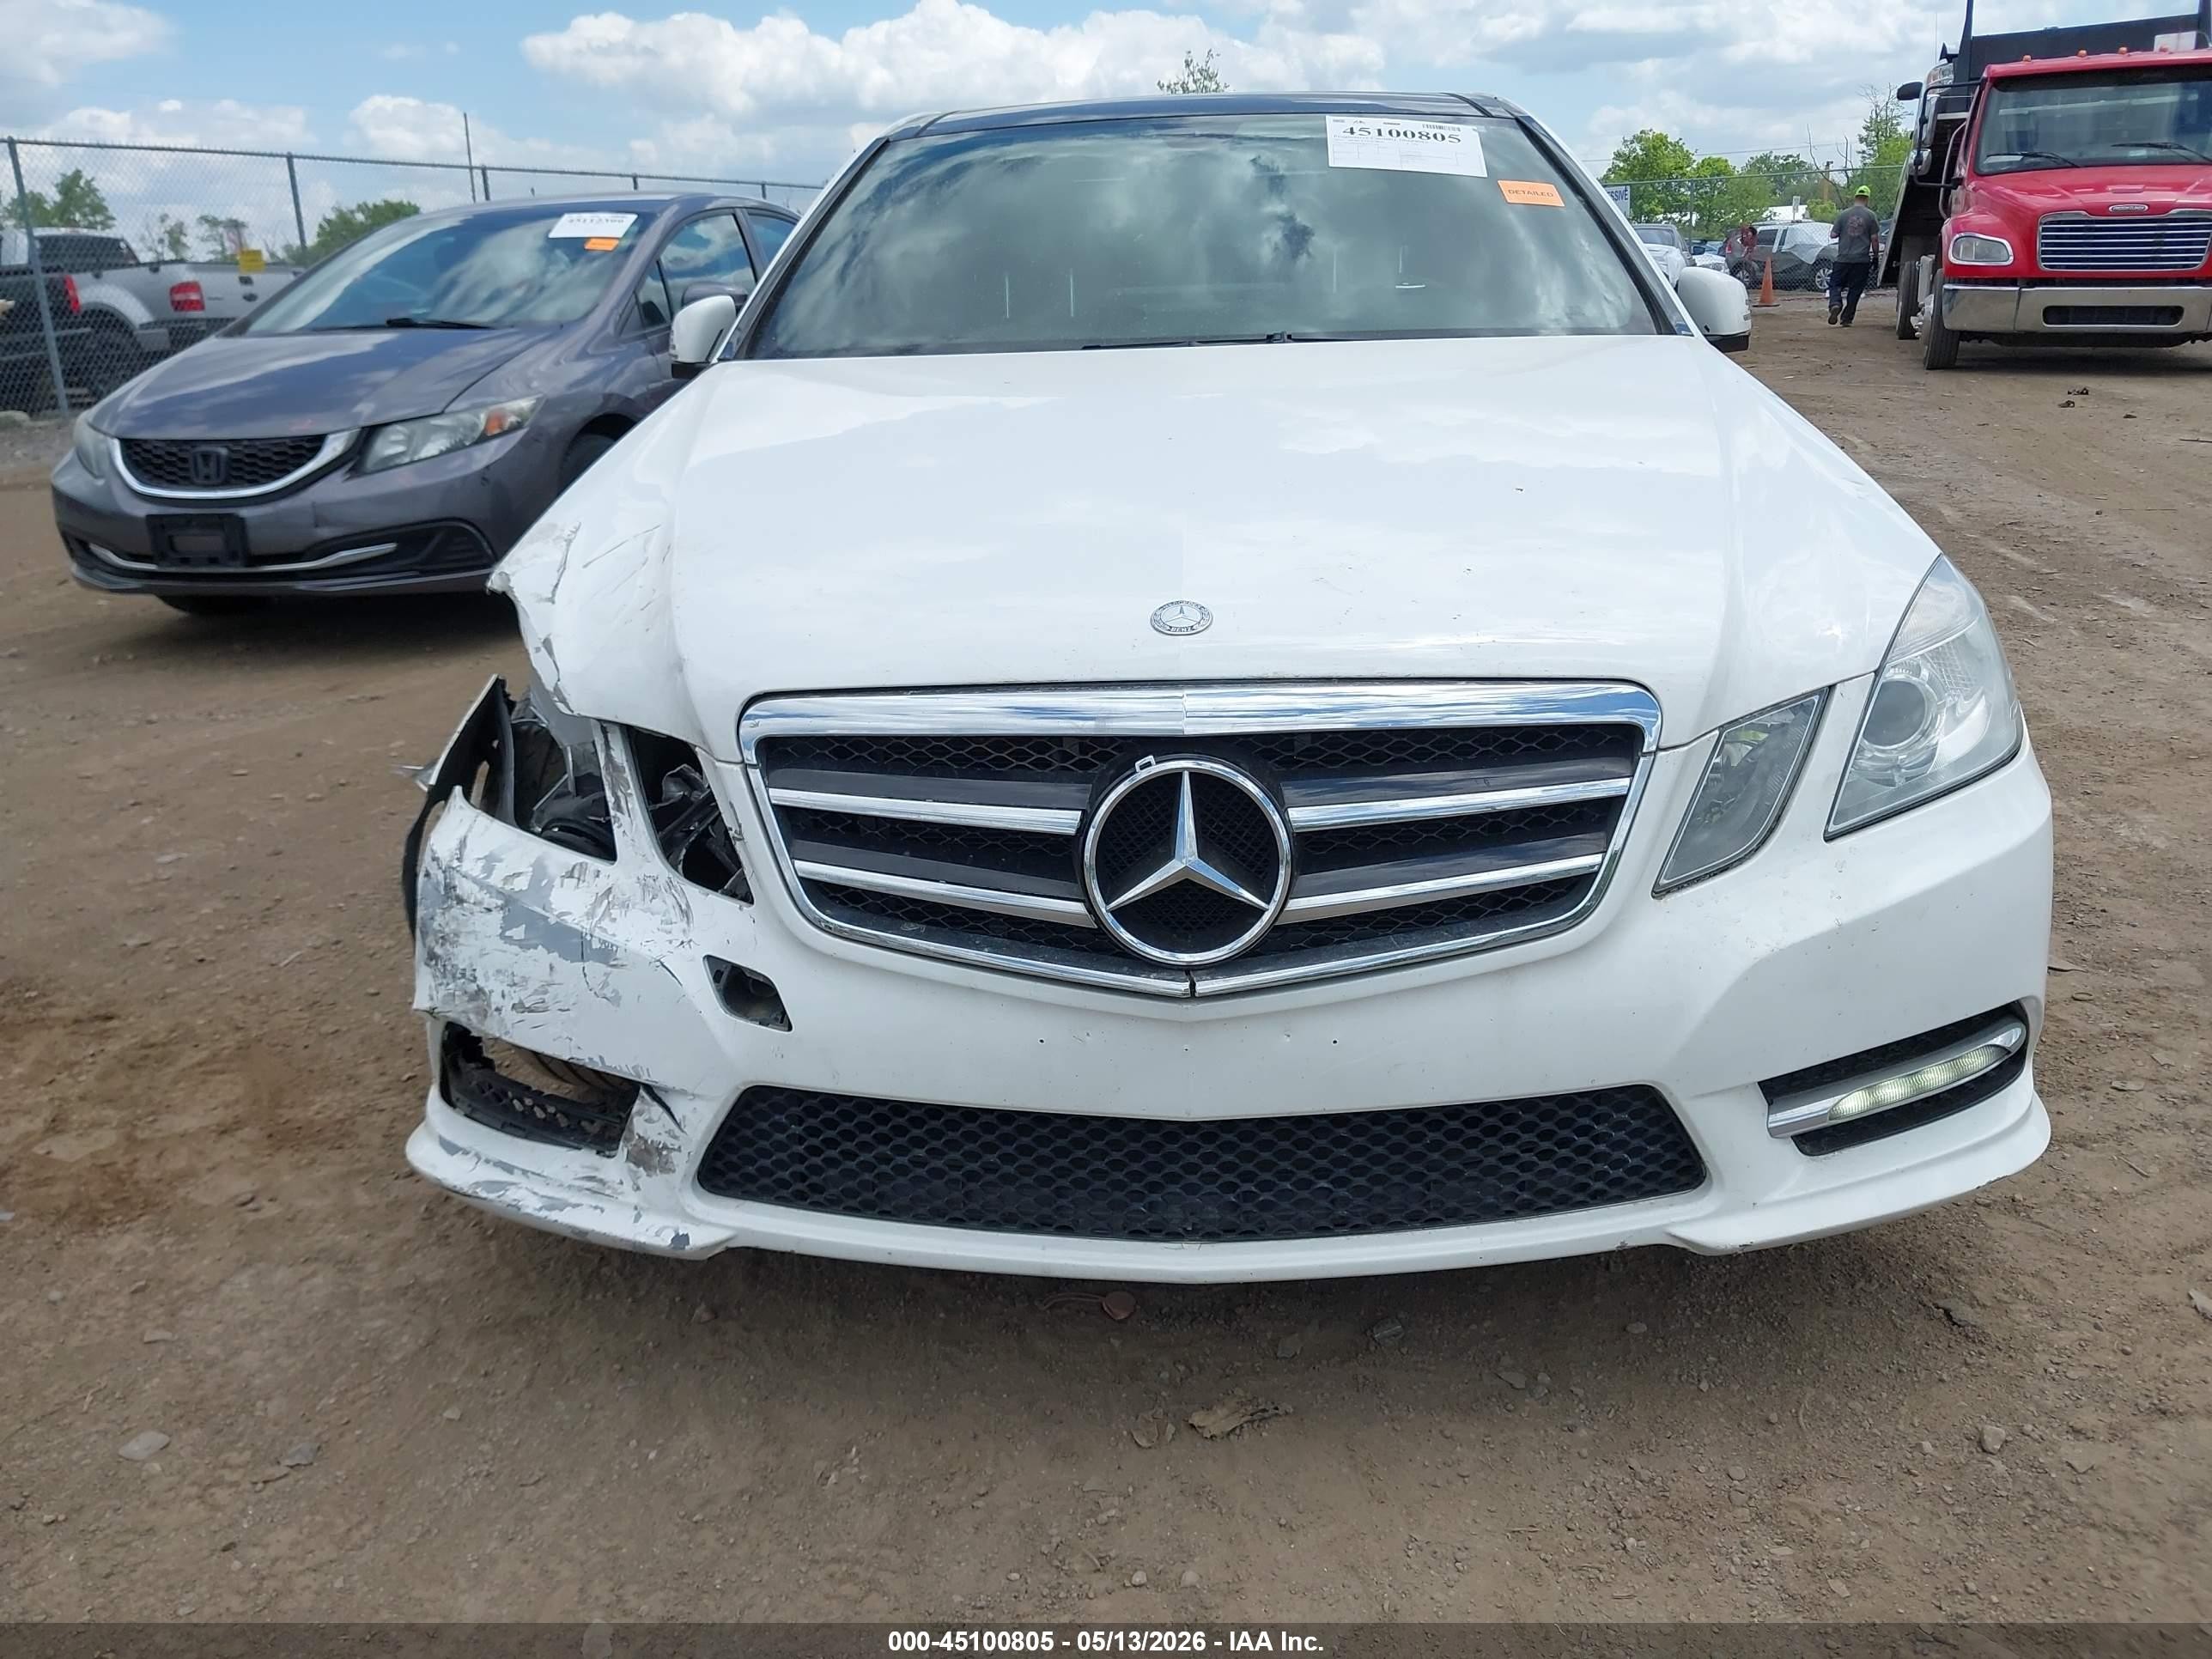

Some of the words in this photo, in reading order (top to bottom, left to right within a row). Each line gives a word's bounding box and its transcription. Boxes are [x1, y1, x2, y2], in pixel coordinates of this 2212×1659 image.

[1342, 126, 1462, 144] 45100805
[1508, 189, 1554, 198] DETAILED
[1607, 189, 1628, 201] SSIVE
